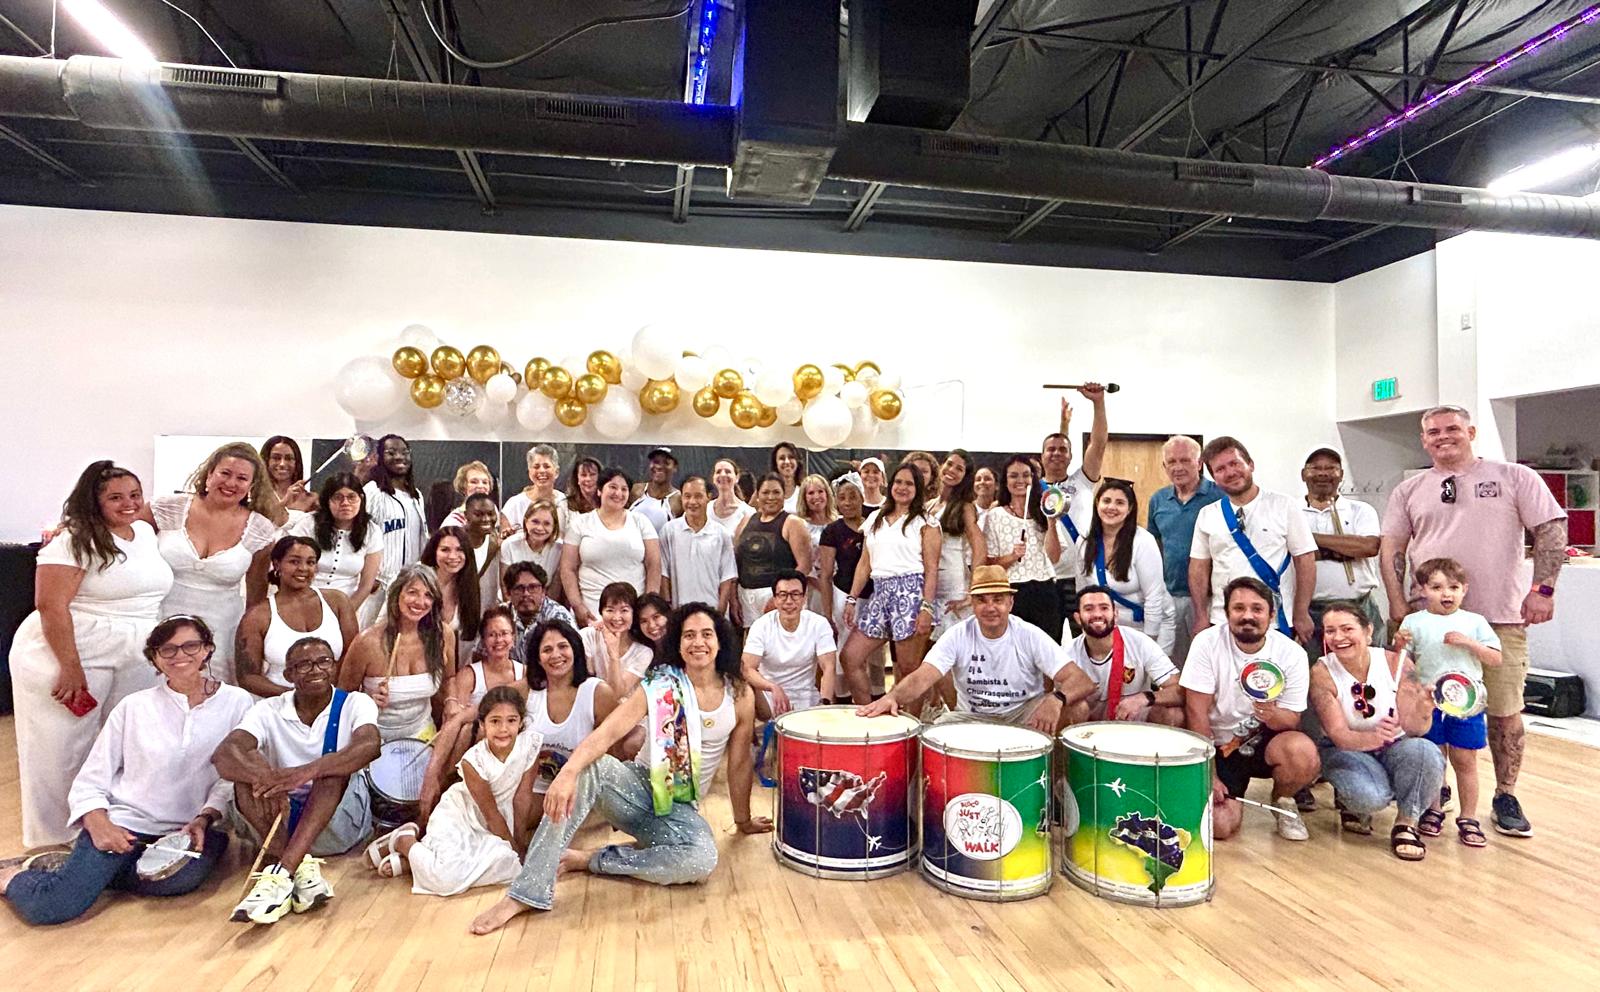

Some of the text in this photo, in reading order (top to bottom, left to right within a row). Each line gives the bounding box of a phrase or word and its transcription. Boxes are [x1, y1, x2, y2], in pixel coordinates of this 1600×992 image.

[1375, 378, 1395, 400] EXIT
[959, 808, 981, 820] JUST
[964, 841, 999, 853] WALK
